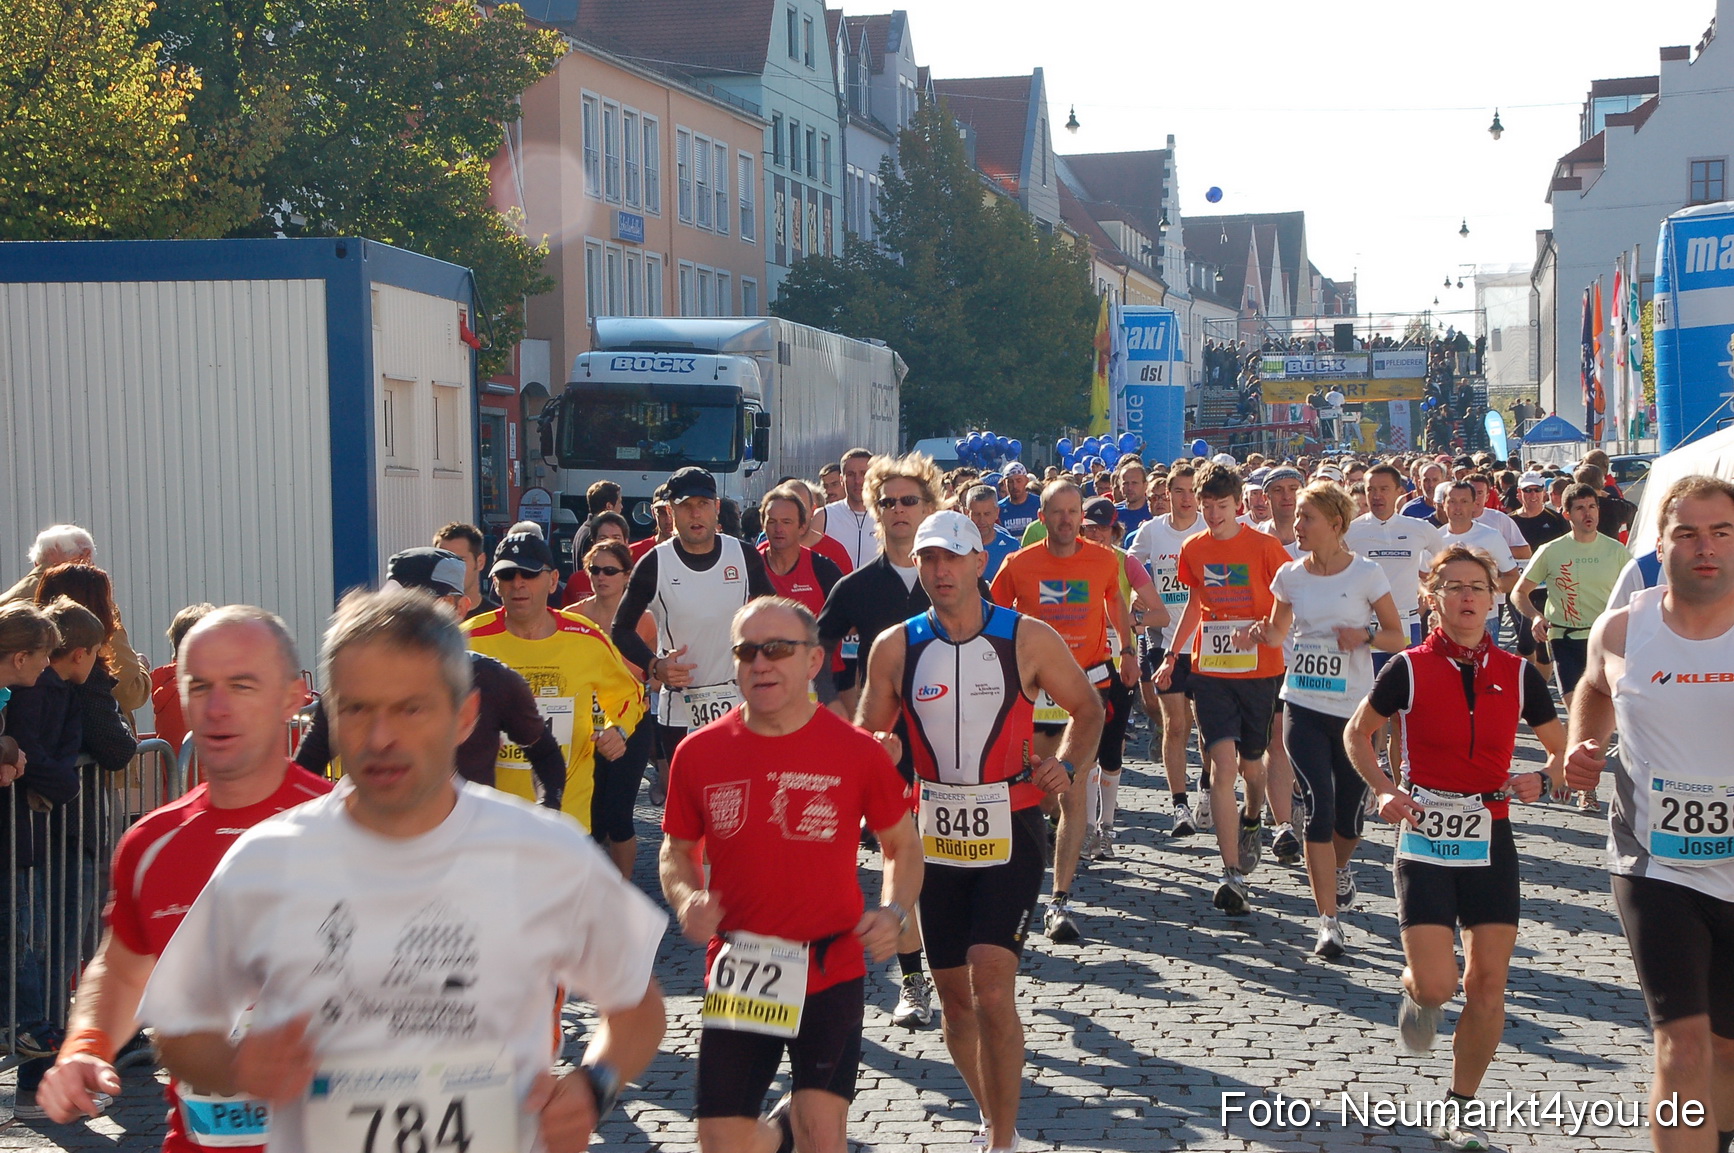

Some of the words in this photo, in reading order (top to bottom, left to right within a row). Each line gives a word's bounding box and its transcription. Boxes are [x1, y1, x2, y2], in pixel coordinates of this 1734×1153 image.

[1126, 321, 1166, 350] axi
[610, 357, 695, 373] BOCK
[1140, 365, 1163, 382] dsl
[1286, 359, 1346, 373] BOCK
[1313, 384, 1368, 396] START
[1004, 518, 1033, 528] HUBER
[1213, 635, 1241, 654] 92
[1294, 654, 1341, 676] 2669
[1298, 676, 1332, 688] Nicole
[691, 701, 733, 727] 3462
[1665, 780, 1714, 794] PFLEIDERER
[935, 806, 990, 838] 848
[1411, 811, 1482, 839] 2392
[1661, 797, 1734, 835] 283
[935, 837, 996, 860] Rüdiger
[1431, 841, 1460, 856] Tina
[1679, 836, 1734, 855] Josef
[716, 956, 782, 999] 672
[705, 992, 789, 1023] Christoph
[211, 1102, 269, 1129] Pete
[347, 1096, 473, 1153] 784
